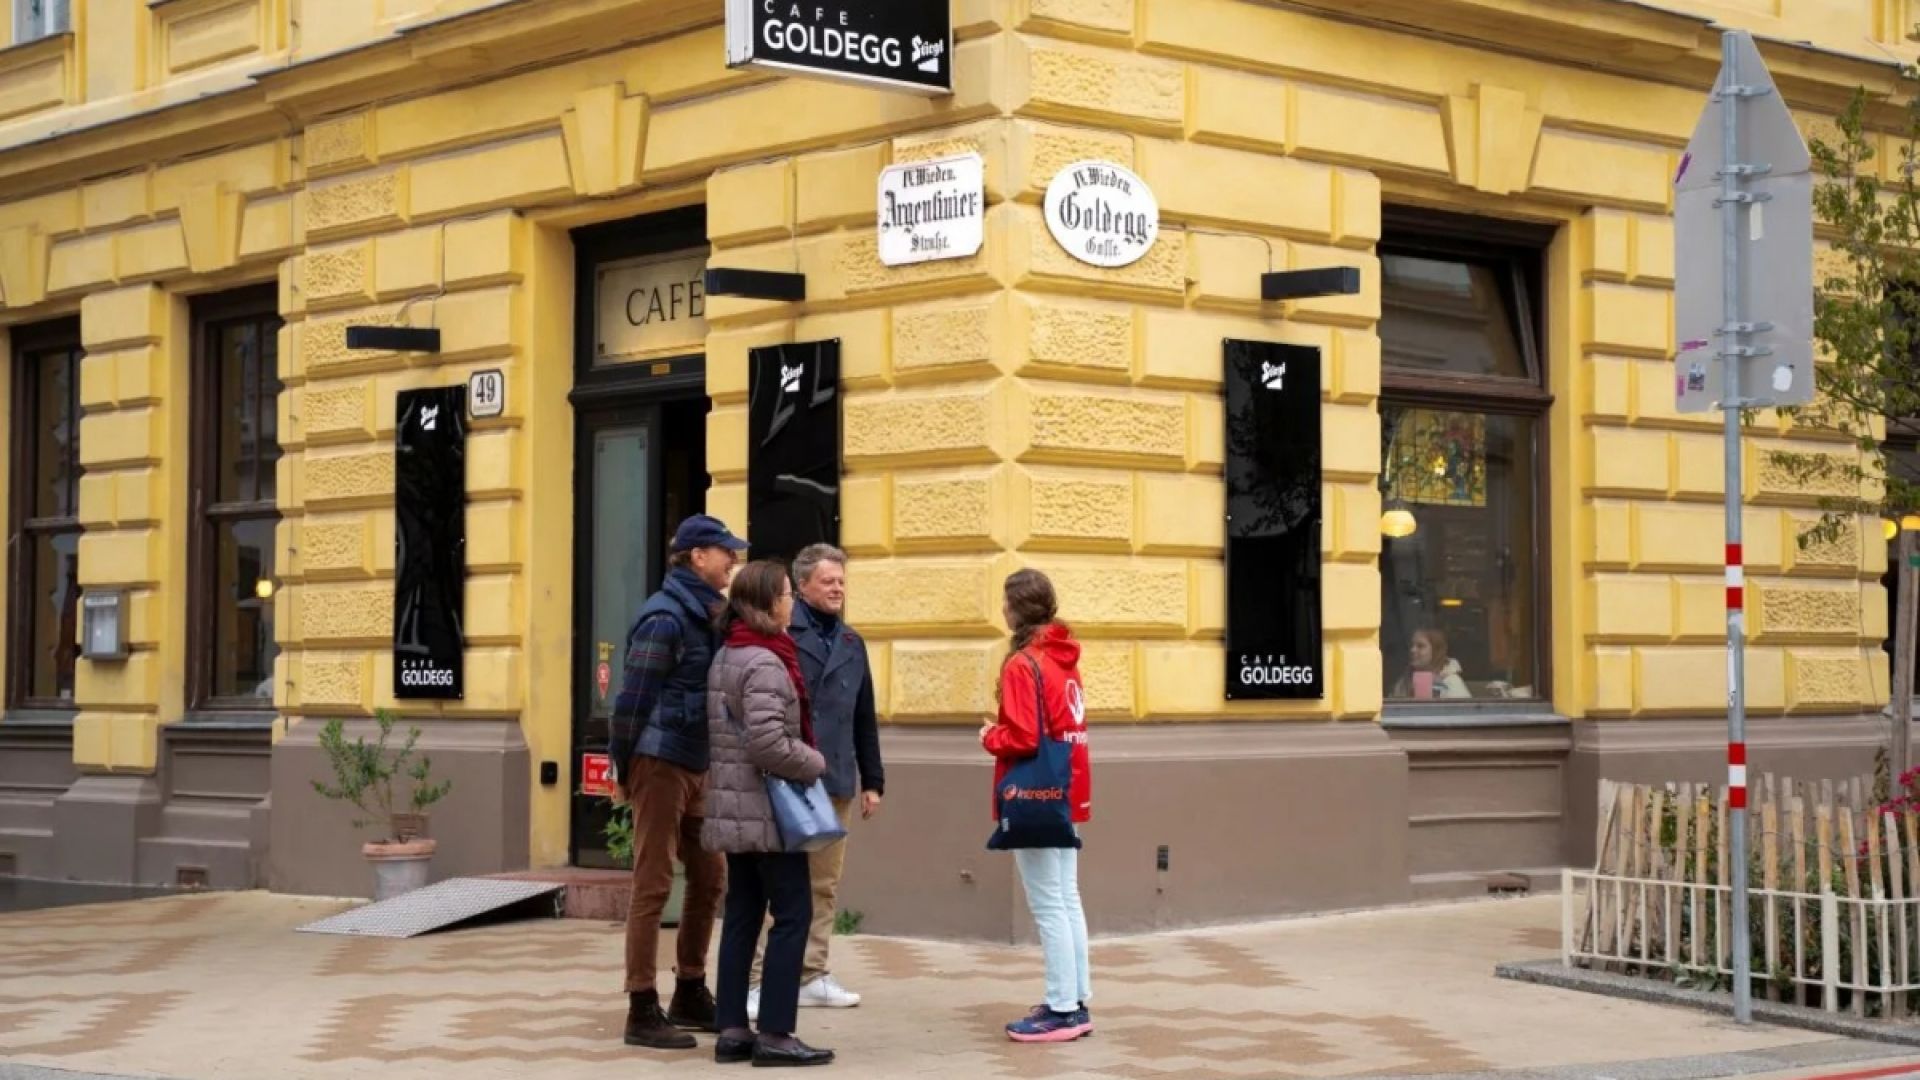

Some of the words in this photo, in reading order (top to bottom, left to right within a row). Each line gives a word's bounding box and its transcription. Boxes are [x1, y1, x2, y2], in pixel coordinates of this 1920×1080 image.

[763, 18, 901, 67] GOLDEGG
[476, 375, 496, 402] 49
[402, 669, 453, 686] GOLDEGG
[1241, 665, 1313, 685] GOLDEGG
